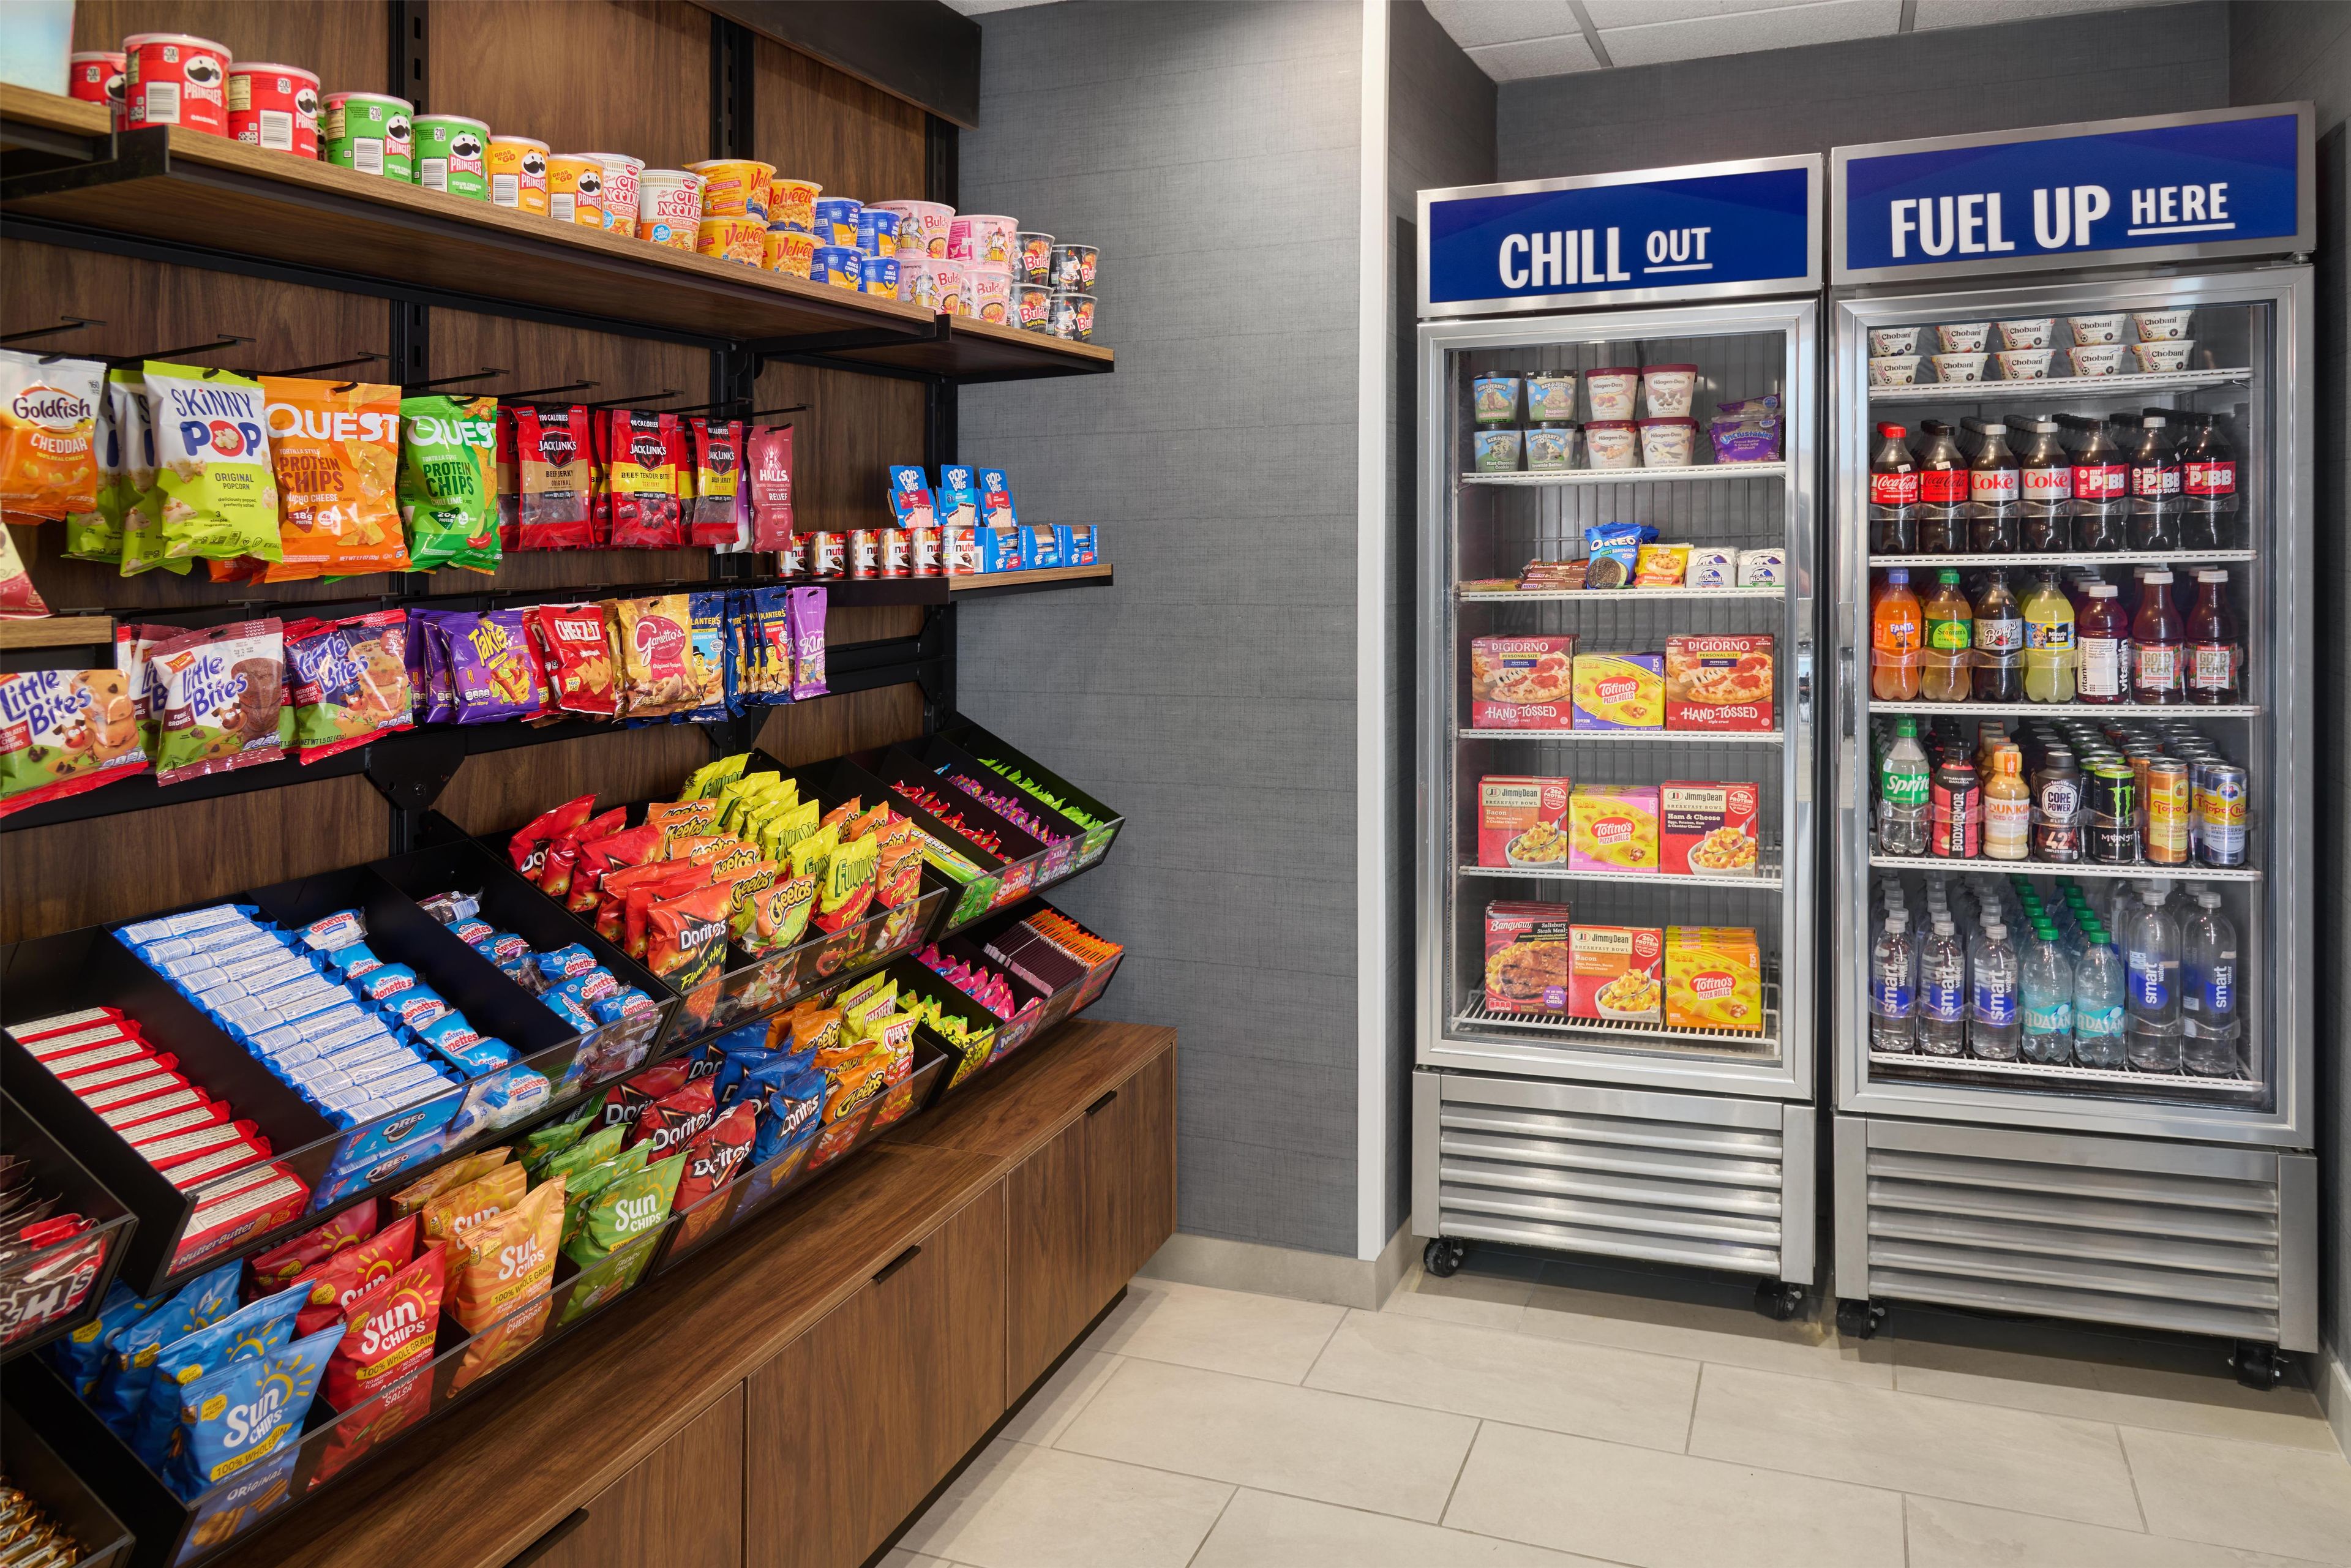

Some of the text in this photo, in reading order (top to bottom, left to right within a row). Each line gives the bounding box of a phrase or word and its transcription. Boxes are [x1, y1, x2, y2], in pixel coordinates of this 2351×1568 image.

[184, 81, 222, 105] PRINGLES
[371, 107, 381, 116] 210
[451, 156, 482, 176] PRINGLES
[521, 174, 546, 192] PRINGLES
[578, 193, 601, 209] PRINGLES
[673, 190, 700, 206] CUP
[1891, 182, 2229, 258] FUEL UP HERE
[1499, 227, 1711, 288] CHILL OUT
[1881, 332, 1911, 340] Chobani
[13, 397, 92, 419] Goldfish
[264, 403, 399, 443] QUEST
[31, 433, 88, 454] CHEDDAR
[179, 420, 261, 457] POP
[1720, 431, 1774, 445] Uncrustables
[630, 443, 667, 456] JACK LINK'S
[280, 456, 341, 472] PROTEIN
[424, 462, 471, 478] PROTEIN
[215, 473, 253, 482] ORIGINAL
[282, 470, 345, 493] CHIPS
[426, 475, 474, 497] CHIPS
[1971, 473, 2014, 490] Coke
[2024, 472, 2068, 489] Coke
[286, 493, 309, 502] NACHO
[310, 493, 338, 502] CHEESE
[769, 492, 788, 501] RELIEF
[293, 512, 313, 520] 18g
[1590, 536, 1637, 551] OREO
[760, 610, 786, 620] PLANTERS
[1984, 621, 2017, 645] Barq's
[468, 625, 508, 667] Takis
[1652, 658, 1659, 667] 15
[2145, 653, 2170, 663] GOLD
[2145, 663, 2170, 673] PEAK
[2200, 653, 2225, 663] GOLD
[2200, 663, 2225, 673] PEAK
[182, 655, 225, 703] Little
[319, 655, 369, 694] Bites
[0, 670, 61, 722] Little
[192, 673, 248, 718] Bites
[296, 686, 317, 695] PATRIOTIC
[1599, 681, 1636, 696] Totino's
[1619, 692, 1633, 702] ROLLS
[28, 686, 92, 737] Bites
[1485, 704, 1557, 720] HAND-TOSSED
[1680, 705, 1758, 721] HAND-TOSSED
[334, 733, 347, 741] (43g)
[1685, 792, 1706, 801] Jimmy
[2048, 792, 2071, 803] CORE
[1595, 822, 1632, 837] Totino's
[1952, 792, 1964, 852] BODYARMOR
[836, 857, 876, 897] FUNYUNS
[998, 872, 1032, 901] Skittles
[731, 870, 773, 910] Cheetos
[769, 880, 812, 926] Cheetos
[311, 912, 353, 935] donettes
[680, 919, 726, 951] Doritos
[1592, 934, 1613, 943] Jimmy
[681, 943, 723, 991] Flamin' Hot
[1693, 976, 1733, 991] Totino's
[2145, 962, 2158, 1005] smart
[2214, 966, 2227, 1008] smart
[1990, 970, 2004, 1021] smart
[443, 1029, 465, 1044] Hostess
[518, 1087, 541, 1100] POWDERED
[833, 1071, 883, 1120] Cheetos
[384, 1111, 426, 1136] OREO
[780, 1093, 819, 1138] Doritos
[650, 1107, 713, 1153] Doritos
[365, 1152, 409, 1180] OREO
[693, 1139, 751, 1178] Doritos
[615, 1193, 656, 1232] Sun
[630, 1211, 661, 1232] CHIPS
[498, 1232, 537, 1281] Sun
[615, 1250, 642, 1269] FRENCH
[493, 1261, 552, 1304] 100% WHOLE GRAIN
[361, 1300, 419, 1355] Sun
[506, 1307, 544, 1335] CHEDDAR
[380, 1318, 427, 1351] CHIPS
[362, 1333, 435, 1378] 100% WHOLE GRAIN
[383, 1382, 413, 1407] SALSA
[223, 1388, 279, 1447] Sun
[250, 1408, 283, 1444] CHIPS
